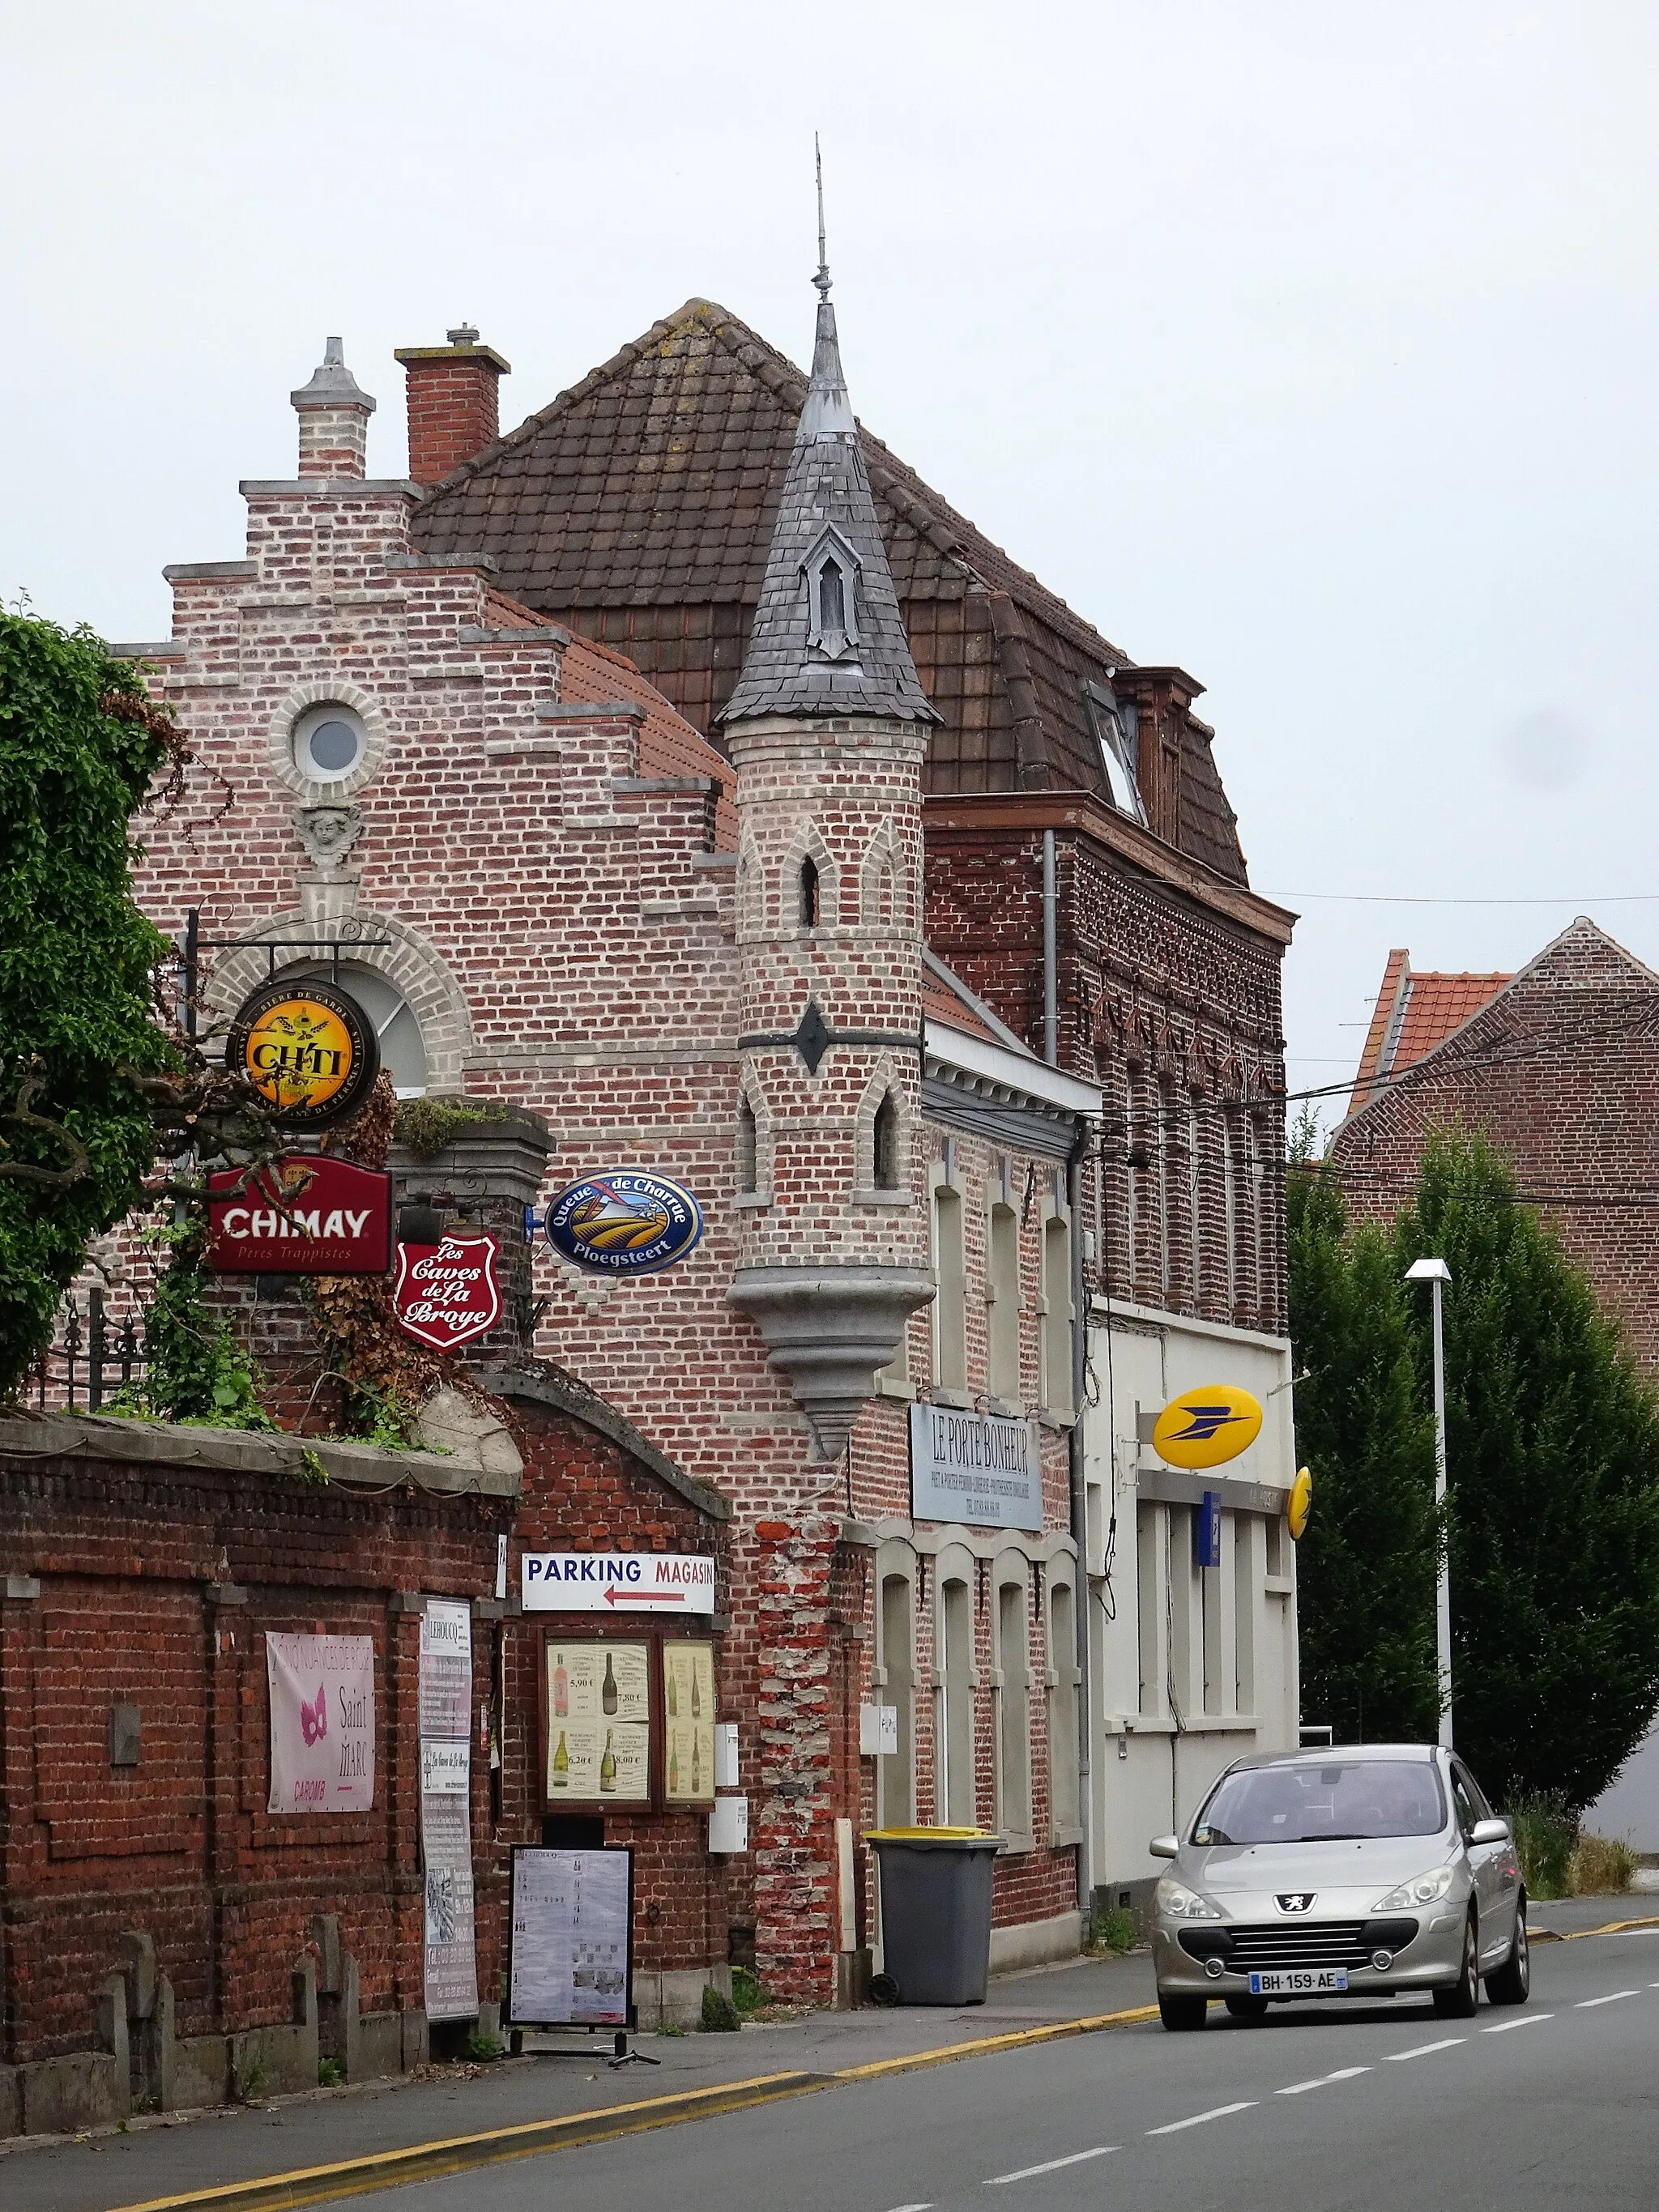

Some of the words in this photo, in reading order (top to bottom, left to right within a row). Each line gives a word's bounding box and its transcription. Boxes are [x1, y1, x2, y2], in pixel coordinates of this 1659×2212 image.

[260, 991, 292, 1012] BIÈRE
[297, 991, 312, 999] DE
[315, 994, 349, 1020] GARDE
[253, 1042, 343, 1076] CH'TI
[315, 1103, 330, 1115] DE
[352, 1031, 361, 1055] FILS
[553, 1186, 593, 1226] Queue
[612, 1177, 632, 1189] de
[633, 1178, 687, 1223] Charrue
[222, 1208, 373, 1239] CHIMAY
[237, 1246, 273, 1259] Pères
[281, 1246, 352, 1263] Trappistes
[429, 1242, 464, 1263] Les
[573, 1239, 672, 1268] Ploegsteert
[412, 1258, 482, 1280] Caves
[421, 1281, 442, 1297] de
[432, 1281, 471, 1306] La
[403, 1301, 487, 1331] Broye
[932, 1413, 946, 1461] LE
[948, 1417, 983, 1468] PORTE
[983, 1421, 1029, 1476] BONHEUR
[528, 1559, 642, 1582] PARKING
[655, 1561, 713, 1585] MAGASIN
[430, 1621, 458, 1644] LEHOUCQ
[301, 1645, 339, 1670] NUANCES
[570, 1679, 587, 1688] 5,90
[589, 1679, 594, 1687] €
[339, 1686, 367, 1728] Saint
[617, 1694, 634, 1702] 7,80
[294, 1780, 326, 1802] CAROMB
[1262, 1973, 1336, 1990] BH-159-AE
